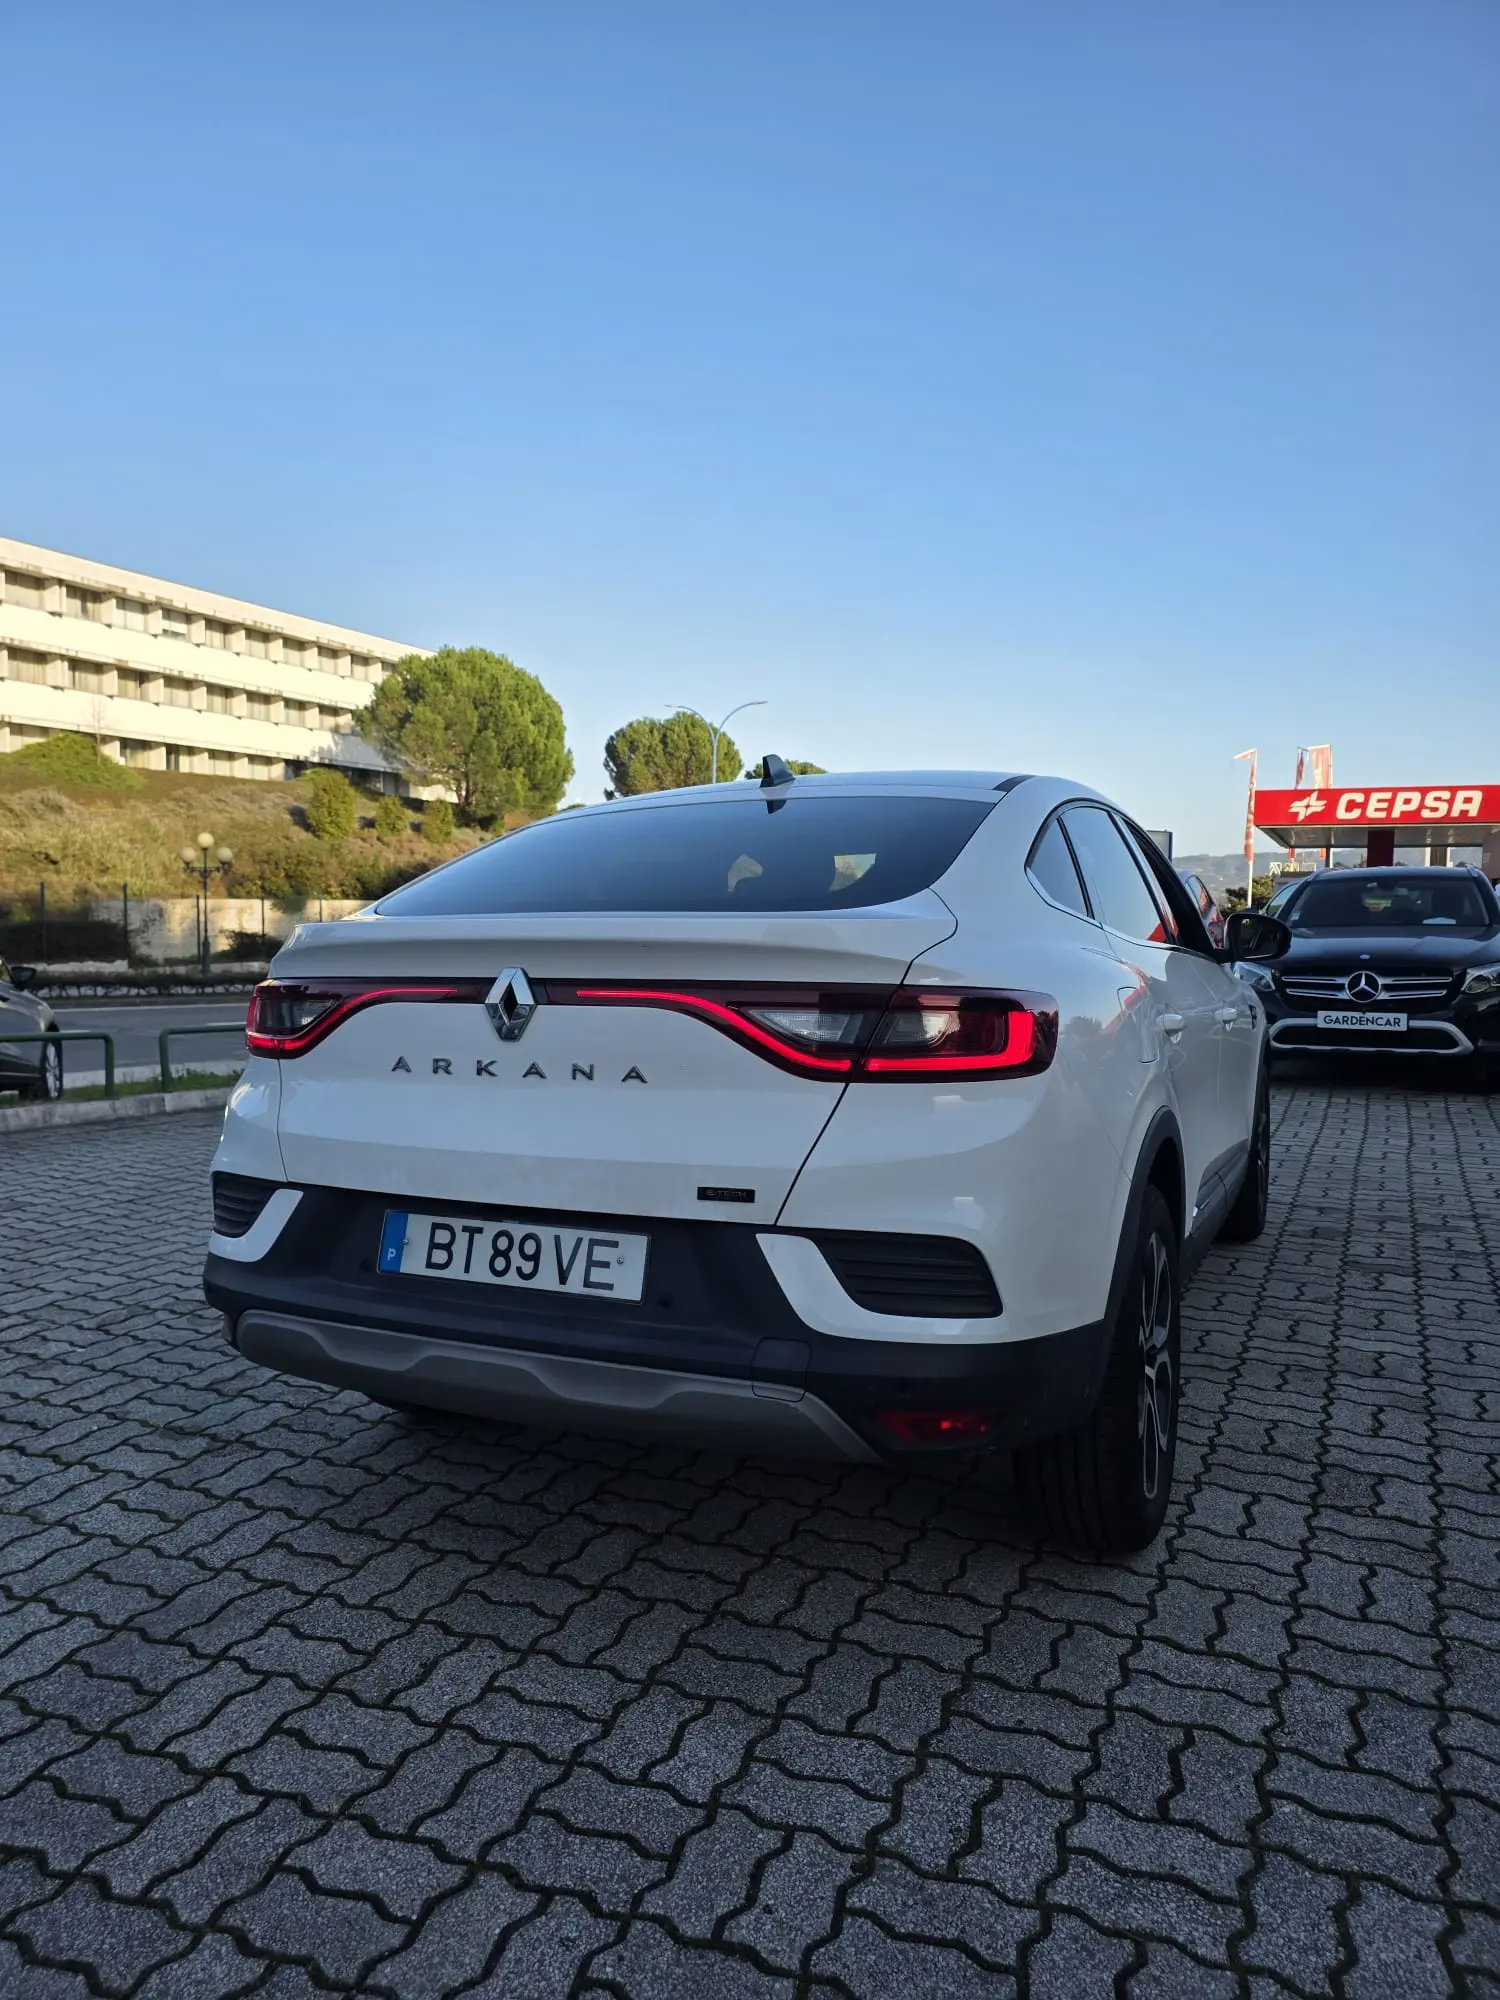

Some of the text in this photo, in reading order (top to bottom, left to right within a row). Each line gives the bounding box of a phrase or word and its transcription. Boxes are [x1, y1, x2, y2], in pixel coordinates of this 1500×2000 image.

[1336, 790, 1483, 819] CEPSA
[1323, 1014, 1401, 1028] GARDENCAR
[391, 1055, 648, 1084] ARKANA
[387, 1248, 397, 1261] P
